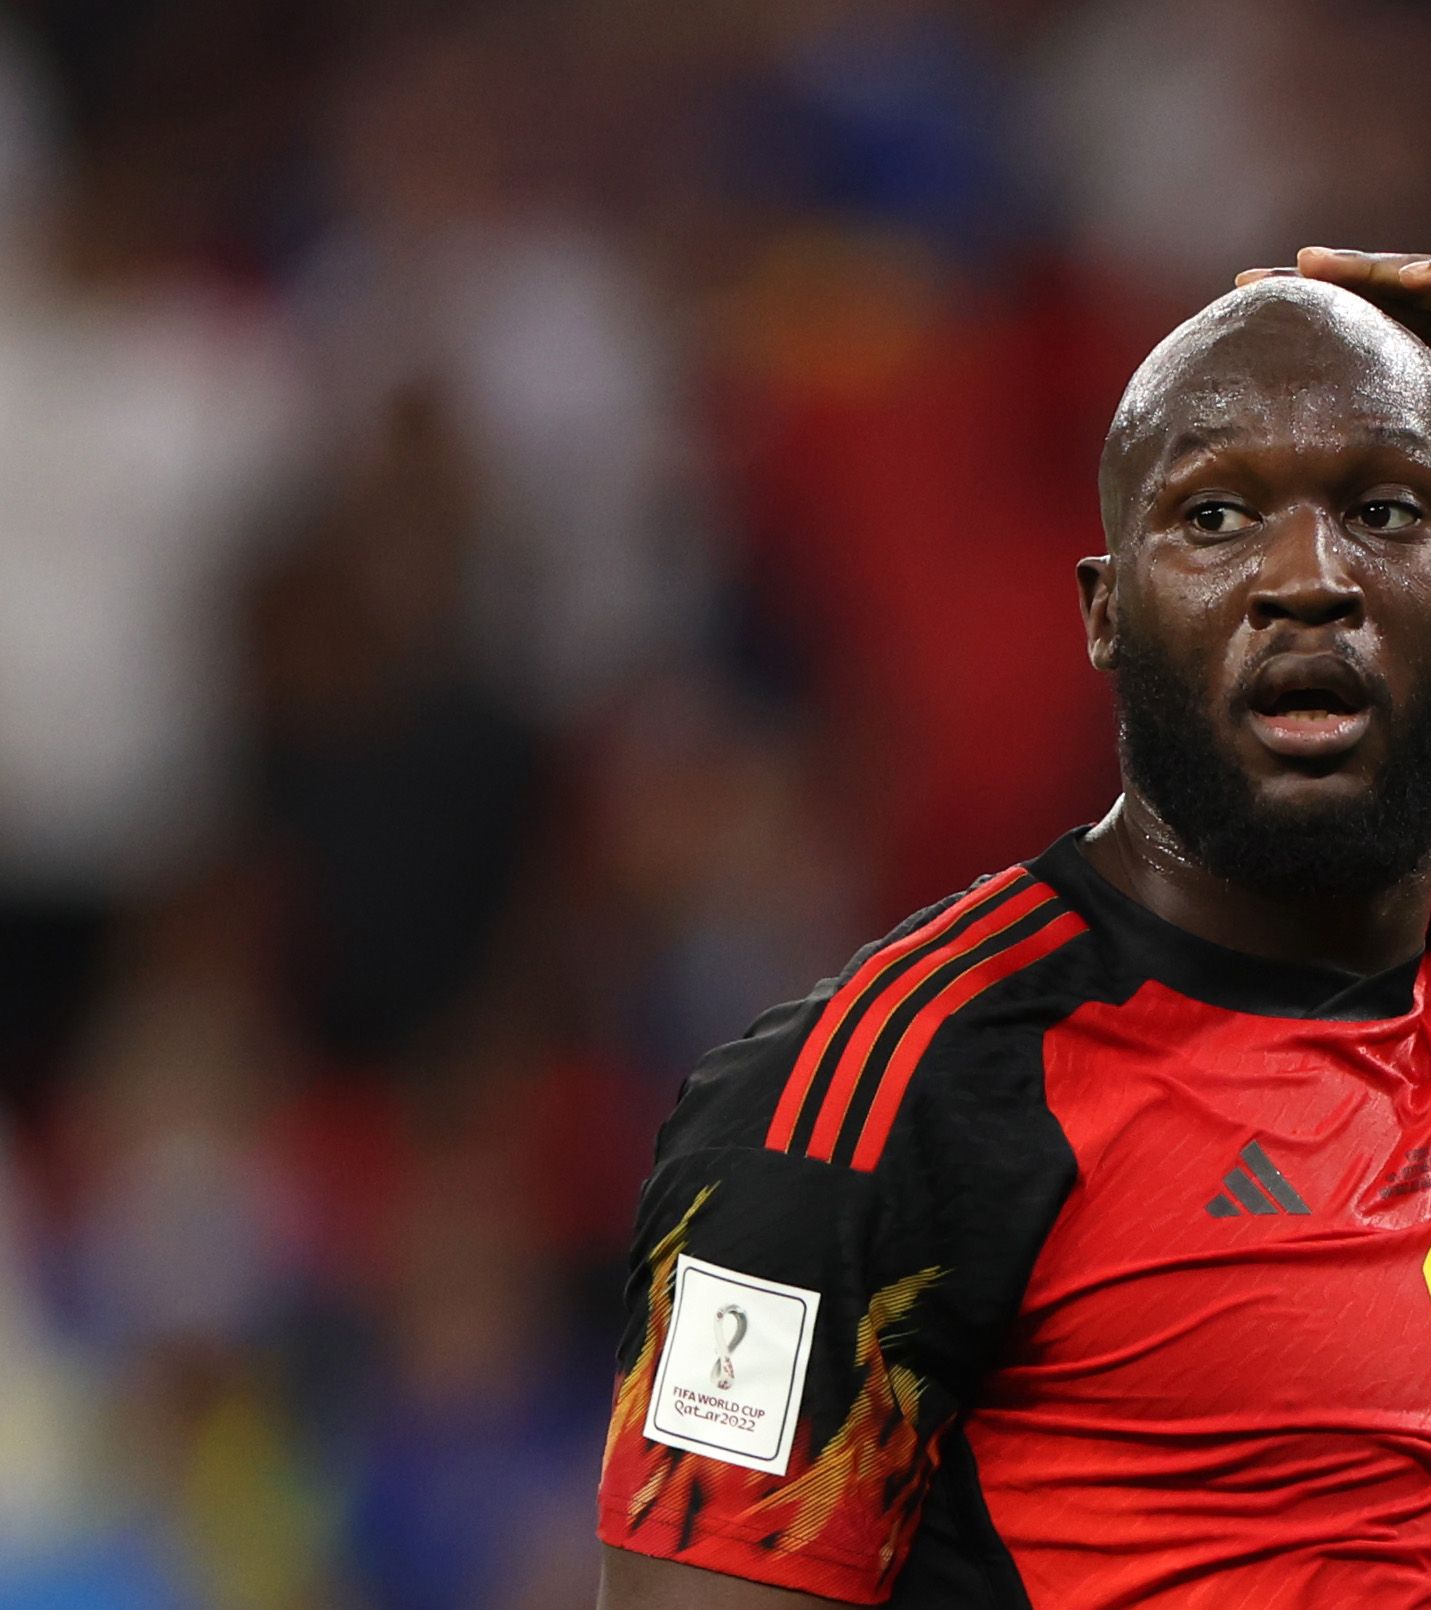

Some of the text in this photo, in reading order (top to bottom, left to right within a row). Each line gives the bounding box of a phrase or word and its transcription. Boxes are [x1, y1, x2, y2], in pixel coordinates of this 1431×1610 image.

[673, 1386, 766, 1419] FIFA WORLD CUP
